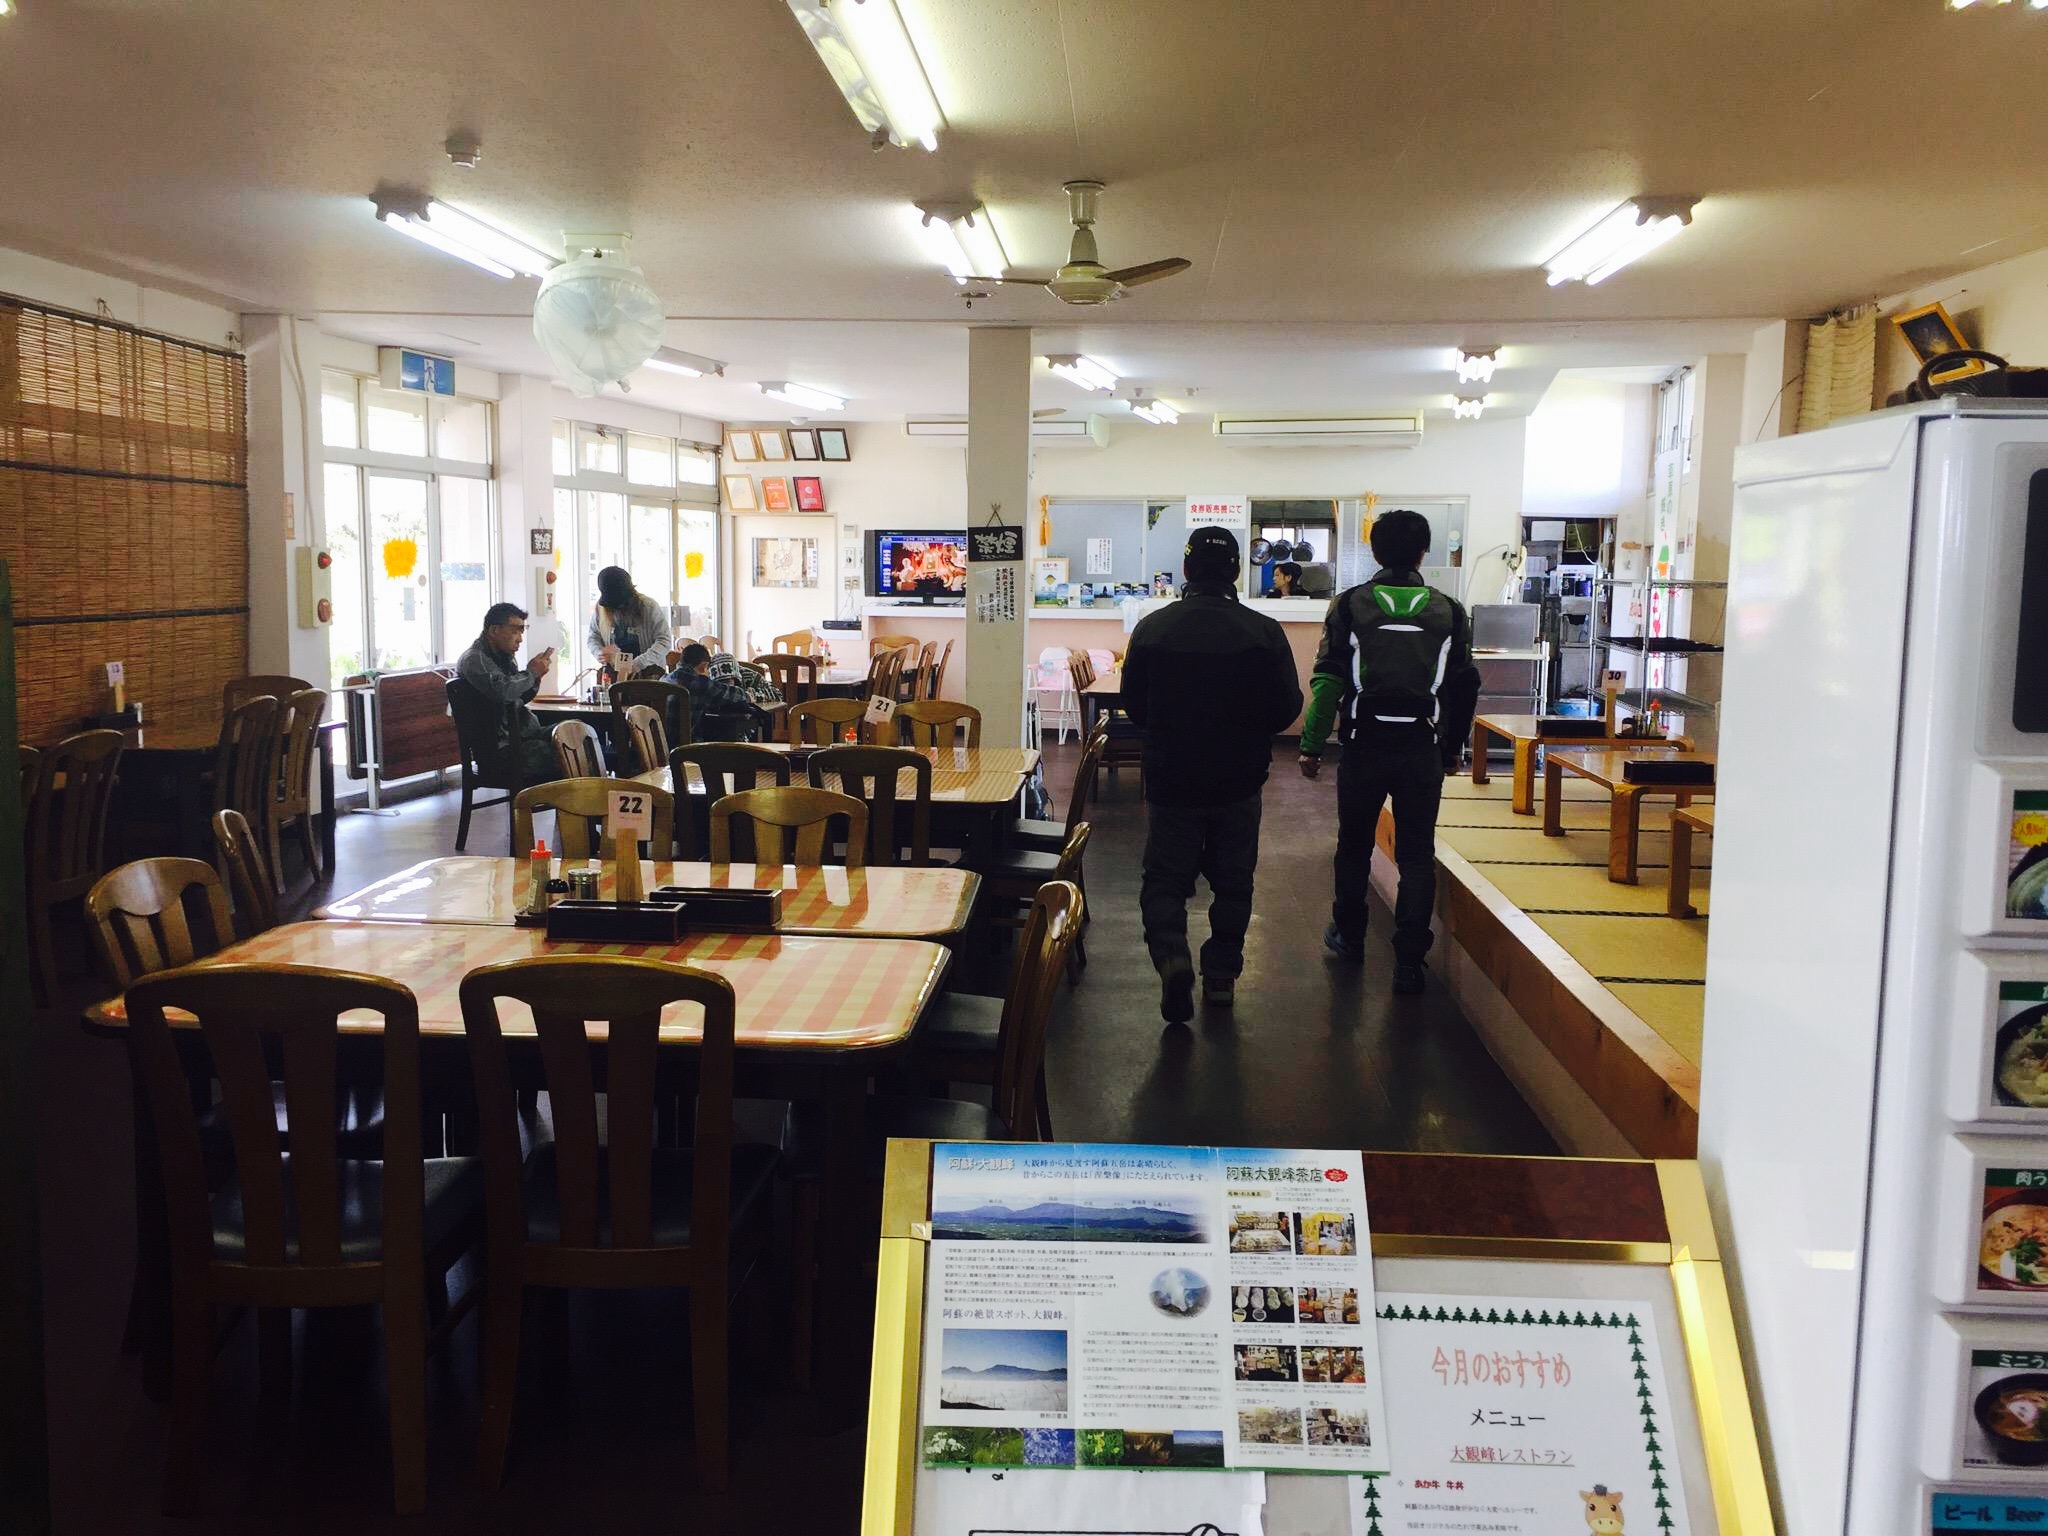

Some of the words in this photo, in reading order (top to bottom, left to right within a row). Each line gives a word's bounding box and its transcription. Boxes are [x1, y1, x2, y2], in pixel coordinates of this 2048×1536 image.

[1191, 504, 1242, 513] 食券販売機にて
[1608, 670, 1621, 680] 30
[875, 700, 890, 712] 21
[619, 796, 643, 814] 22
[1226, 1166, 1323, 1183] 阿蘇大観峰茶店
[942, 1308, 1068, 1321] 阿蘇の絶景スポット、大観峰。
[1432, 1346, 1571, 1388] 今月のおすすめ
[1999, 1353, 2048, 1369] ミニう
[1470, 1408, 1546, 1427] メニュー
[1450, 1445, 1573, 1464] 大観峰レストラン
[1945, 1504, 1994, 1522] ビール
[2006, 1505, 2046, 1522] Beer
